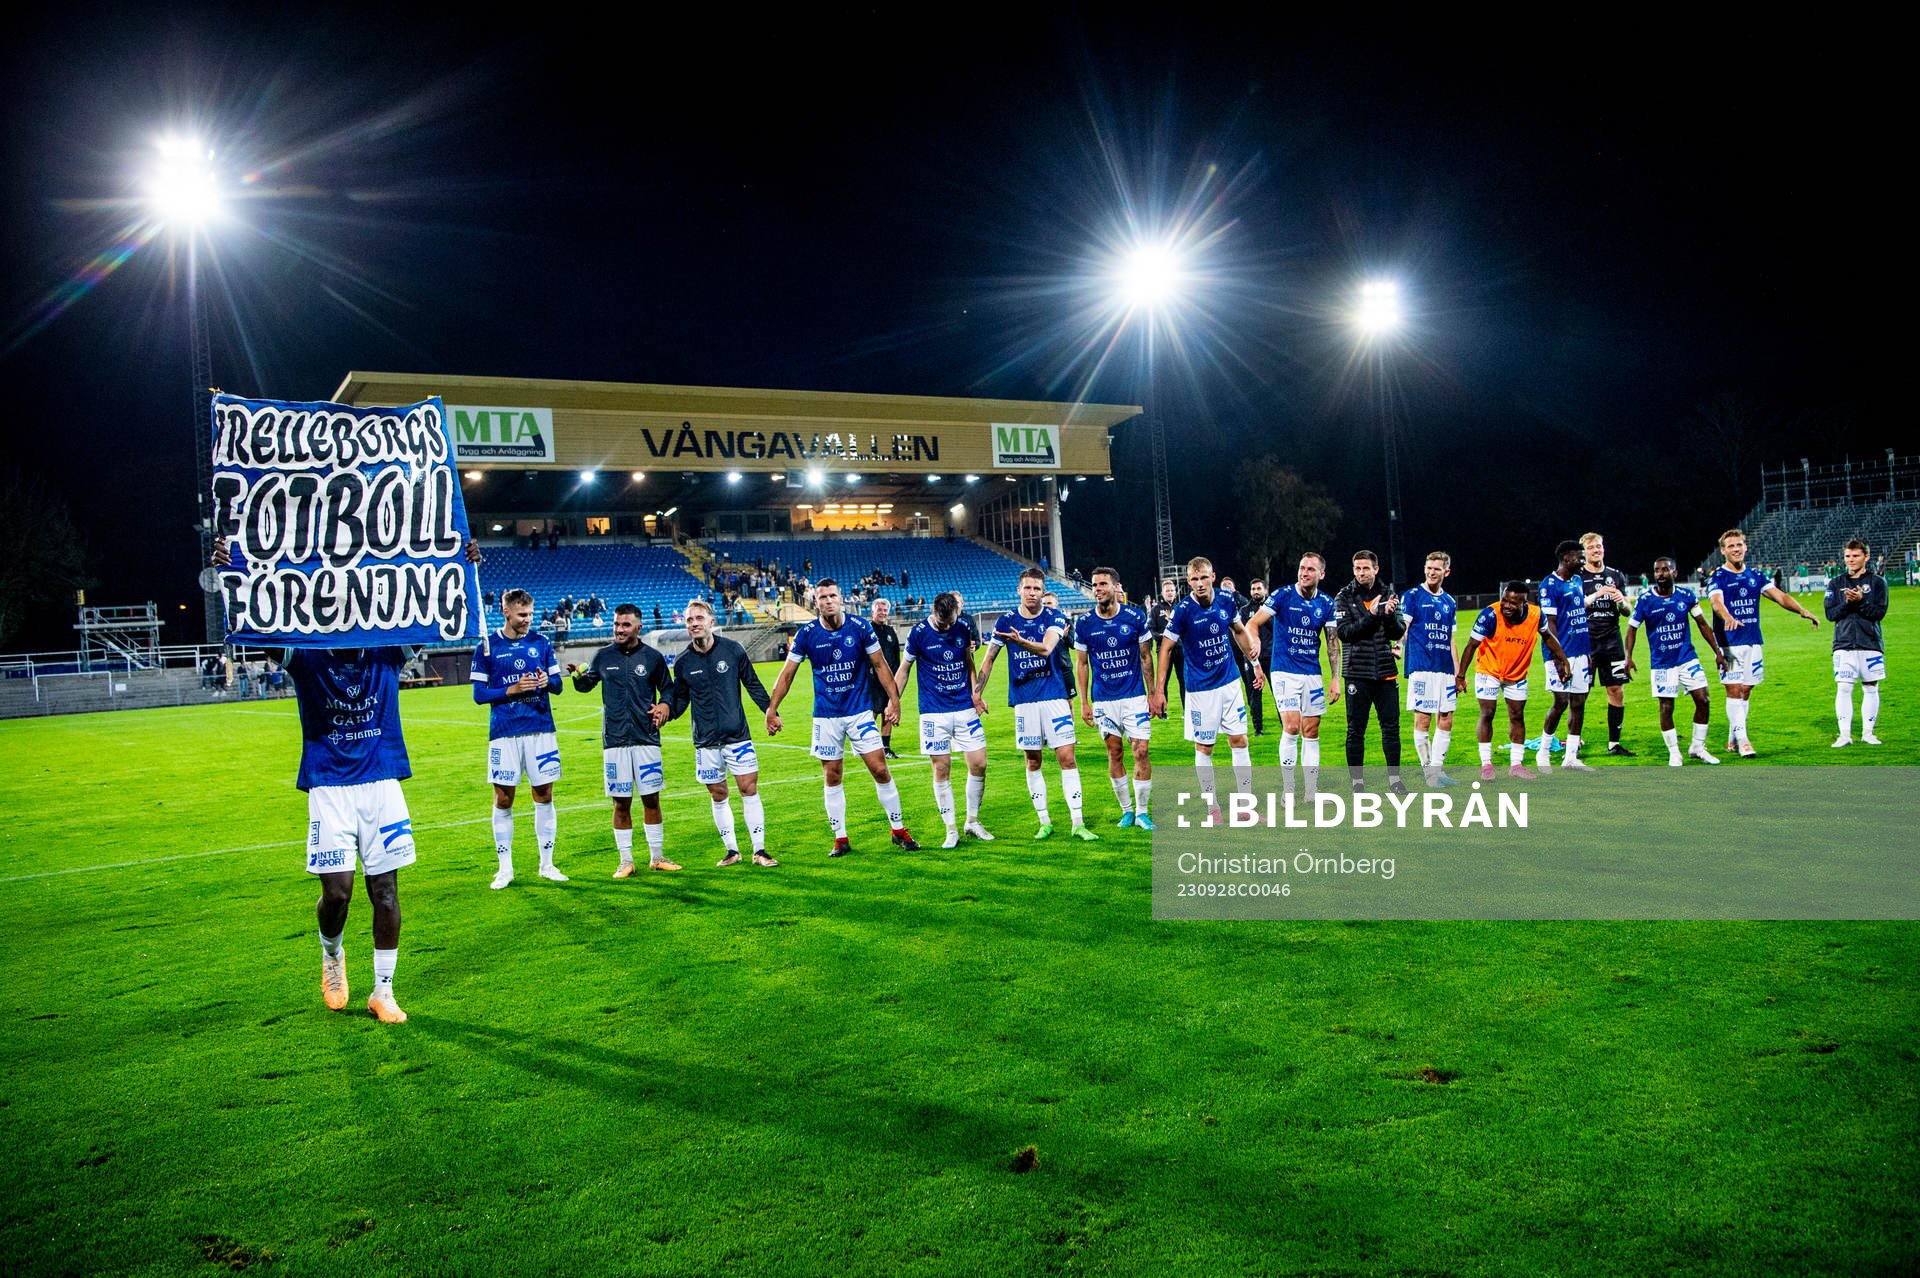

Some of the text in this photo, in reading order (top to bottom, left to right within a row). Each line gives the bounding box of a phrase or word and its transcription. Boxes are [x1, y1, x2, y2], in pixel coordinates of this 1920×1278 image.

[455, 410, 543, 444] MTA
[640, 421, 940, 462] VÅNGAVALLEN
[997, 427, 1052, 453] MTA
[458, 446, 544, 456] Bygg och Anläggning
[213, 471, 457, 568] FOTBOLL
[1096, 648, 1130, 660] MELLBY
[821, 660, 856, 673] MELLBY
[1019, 659, 1047, 669] GÅRD
[1101, 659, 1128, 670] GÅRD
[826, 672, 852, 683] GÅRD
[317, 849, 345, 859] INTER
[317, 857, 345, 867] SPORT
